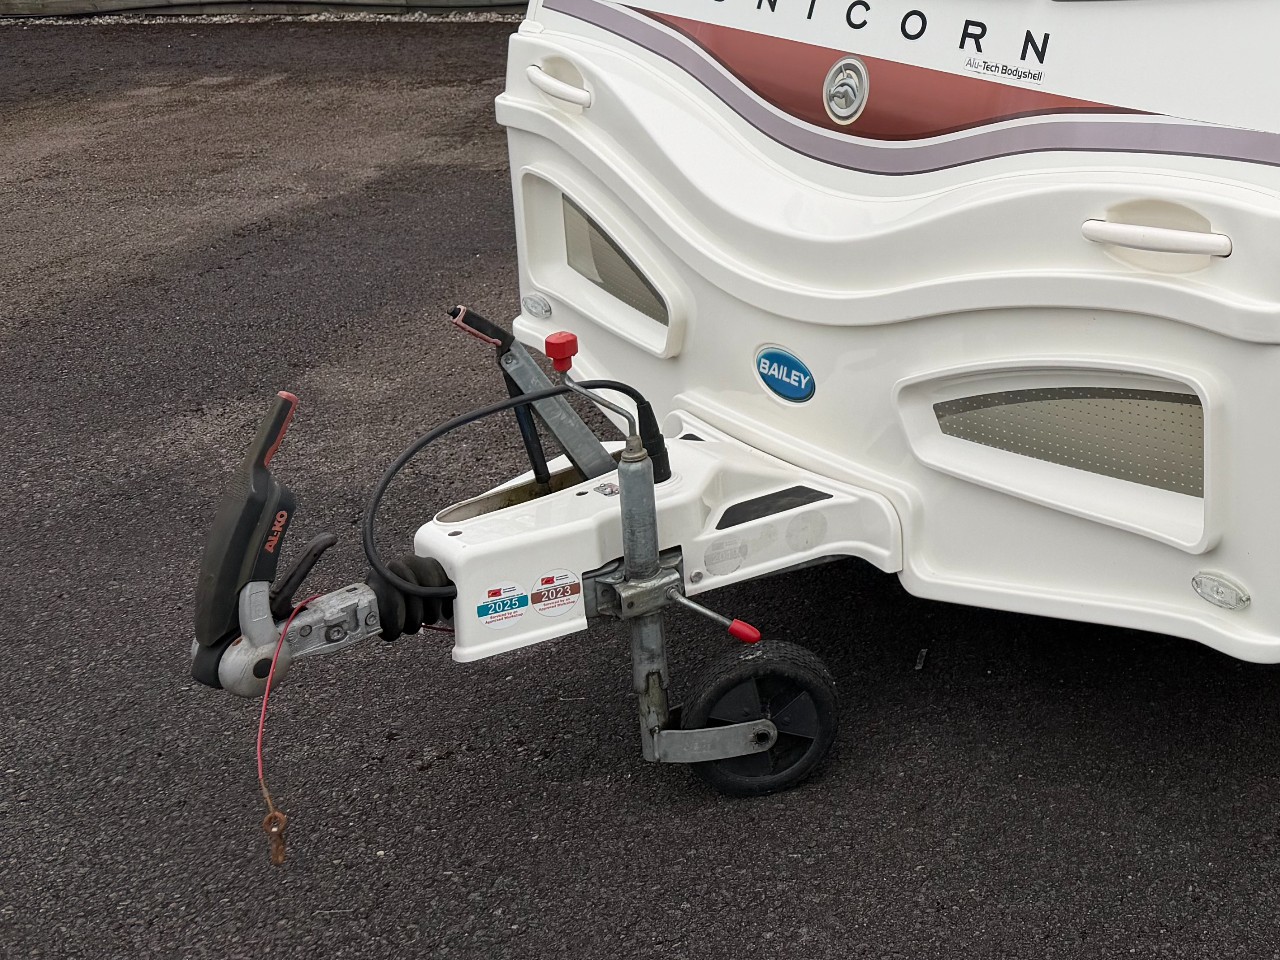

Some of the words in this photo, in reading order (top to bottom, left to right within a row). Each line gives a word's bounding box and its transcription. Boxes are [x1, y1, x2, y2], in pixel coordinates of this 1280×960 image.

[965, 58, 1000, 73] Alu-Tech
[1001, 65, 1043, 81] Bodyshell
[760, 357, 810, 389] BAILEY
[264, 510, 288, 553] AL-KO
[541, 585, 572, 602] 2023
[487, 598, 519, 614] 2025
